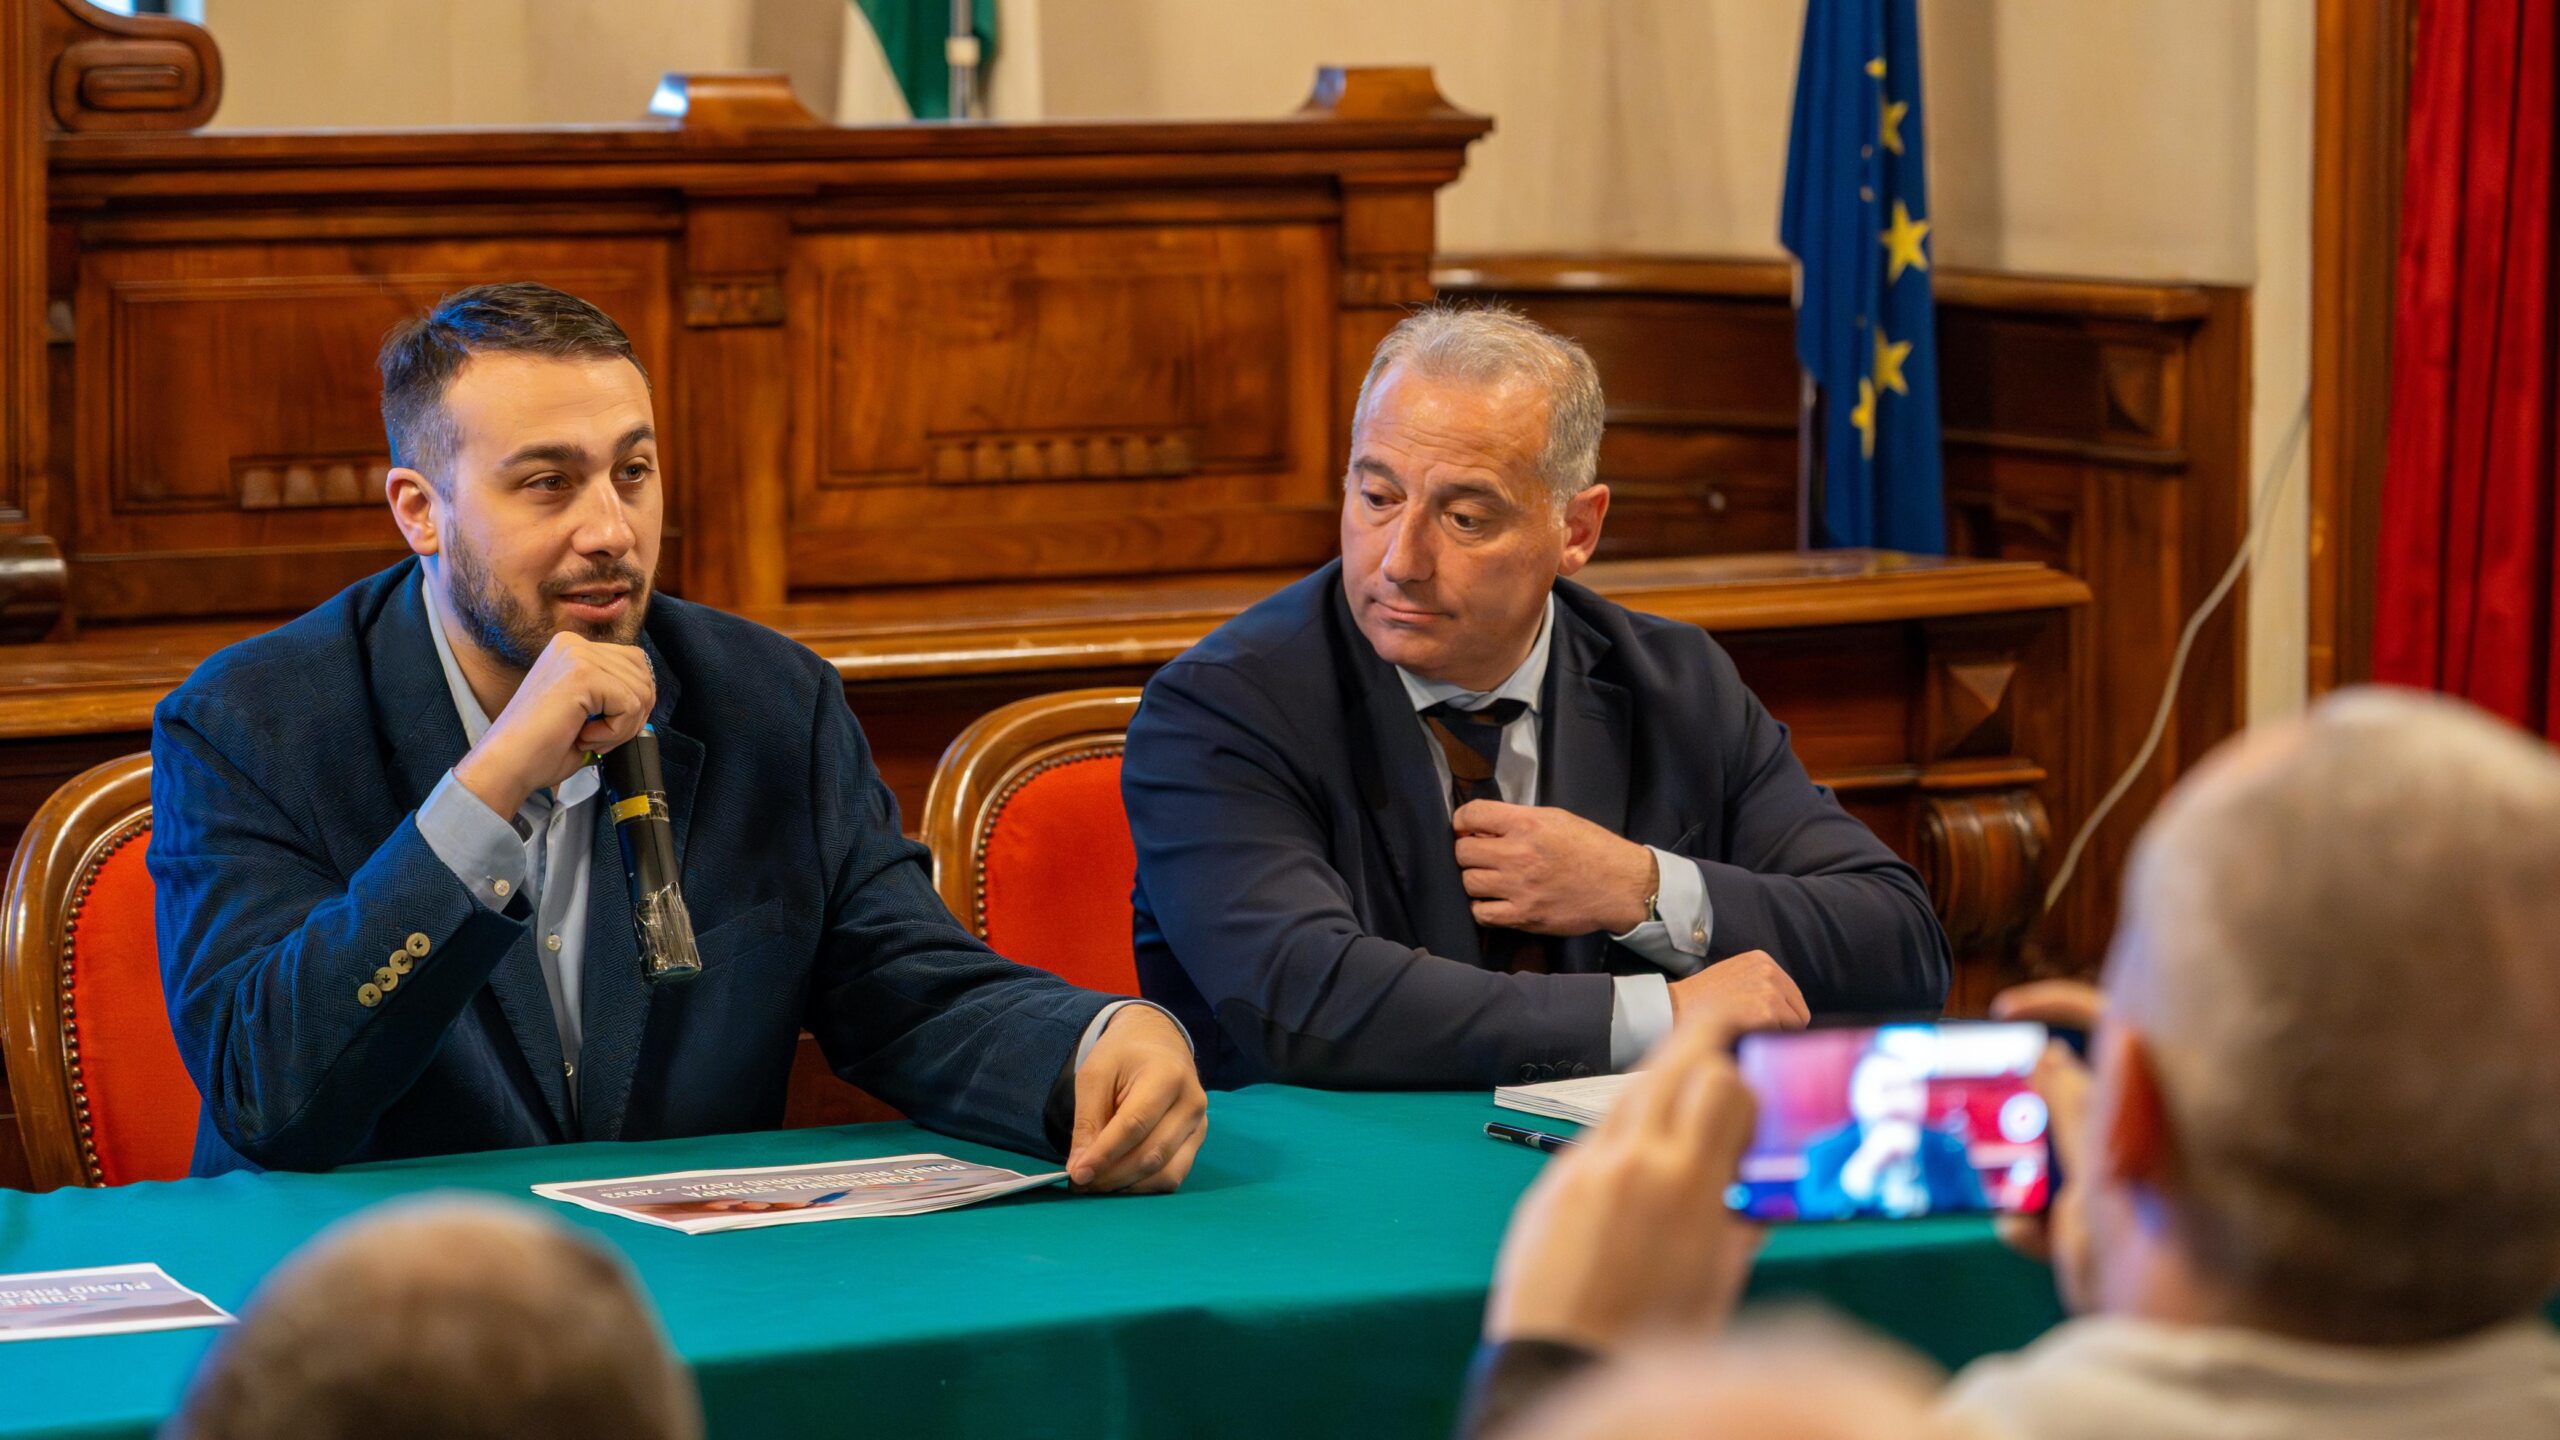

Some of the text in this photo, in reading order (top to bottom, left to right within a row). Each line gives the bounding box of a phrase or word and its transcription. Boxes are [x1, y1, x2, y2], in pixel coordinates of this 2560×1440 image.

[894, 1164, 967, 1176] PIANO
[743, 1170, 893, 1187] RIEQUILIBRIO
[681, 1175, 925, 1198] CONFERENZA STAMPA
[681, 1182, 742, 1191] 2024
[69, 1281, 152, 1294] PIANO
